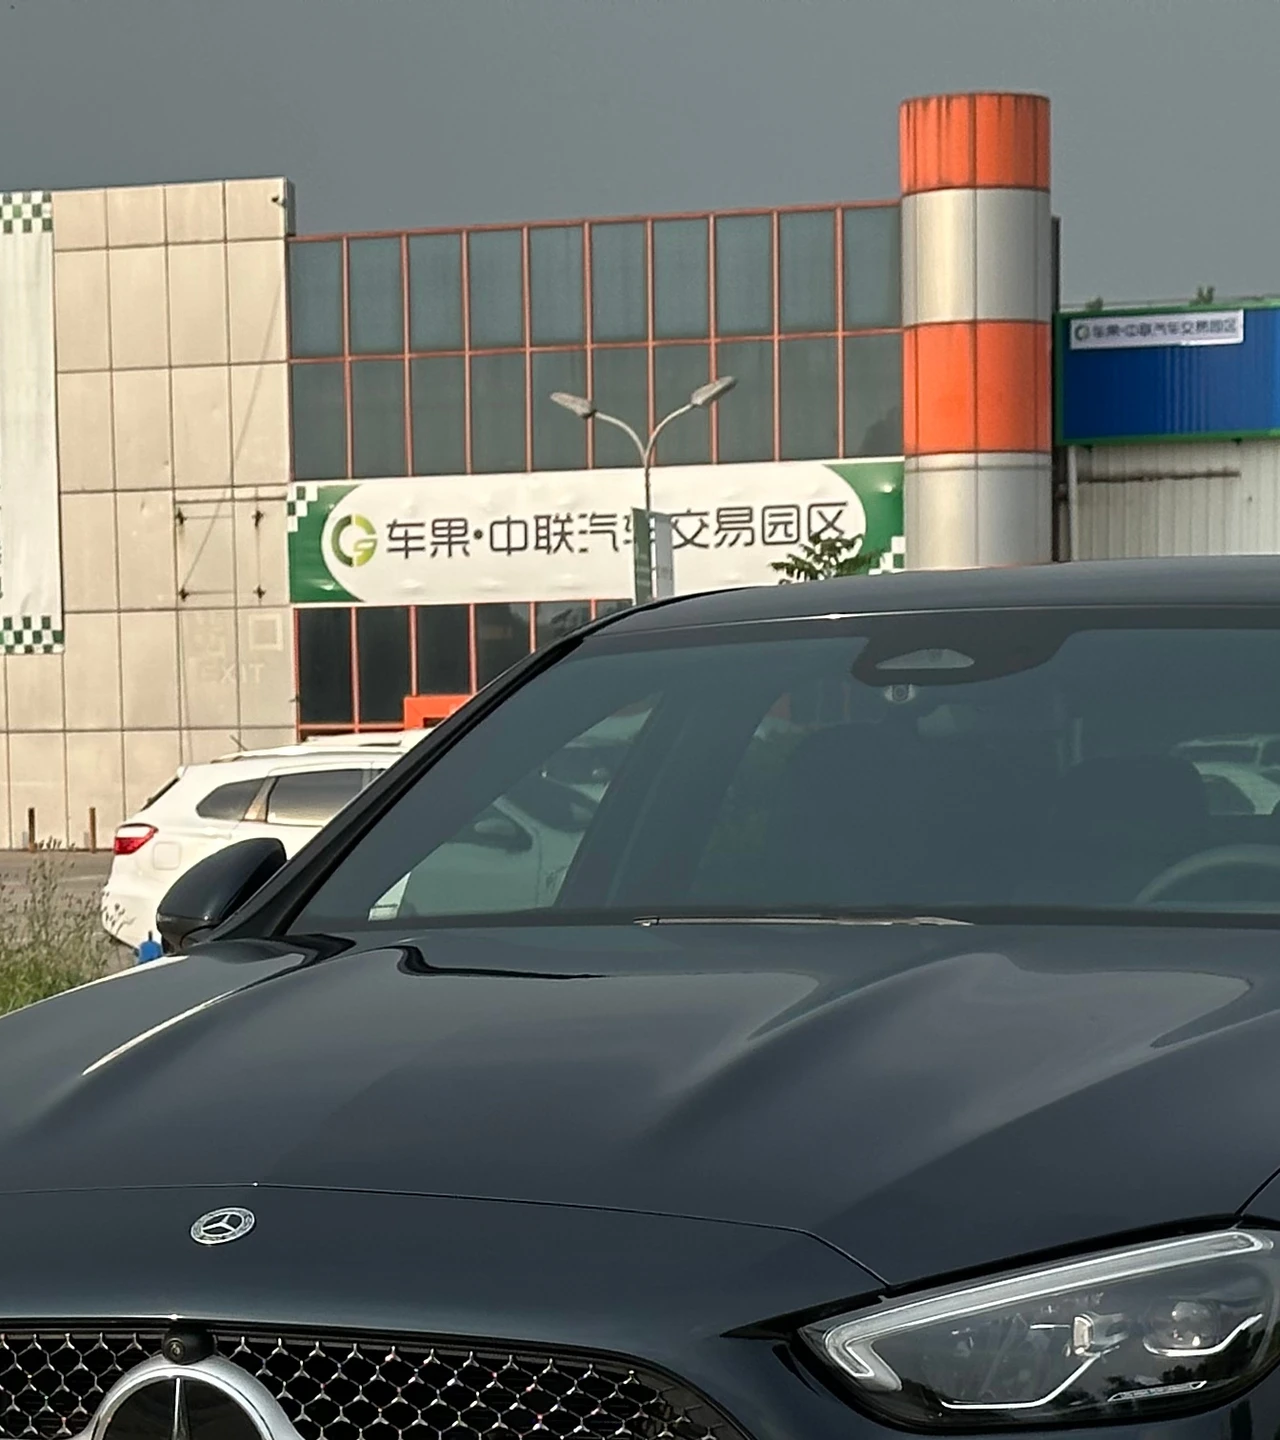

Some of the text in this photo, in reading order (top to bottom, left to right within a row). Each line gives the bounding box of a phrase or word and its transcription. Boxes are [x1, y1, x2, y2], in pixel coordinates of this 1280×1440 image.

[385, 502, 850, 560] 车果·中联汽交易园区
